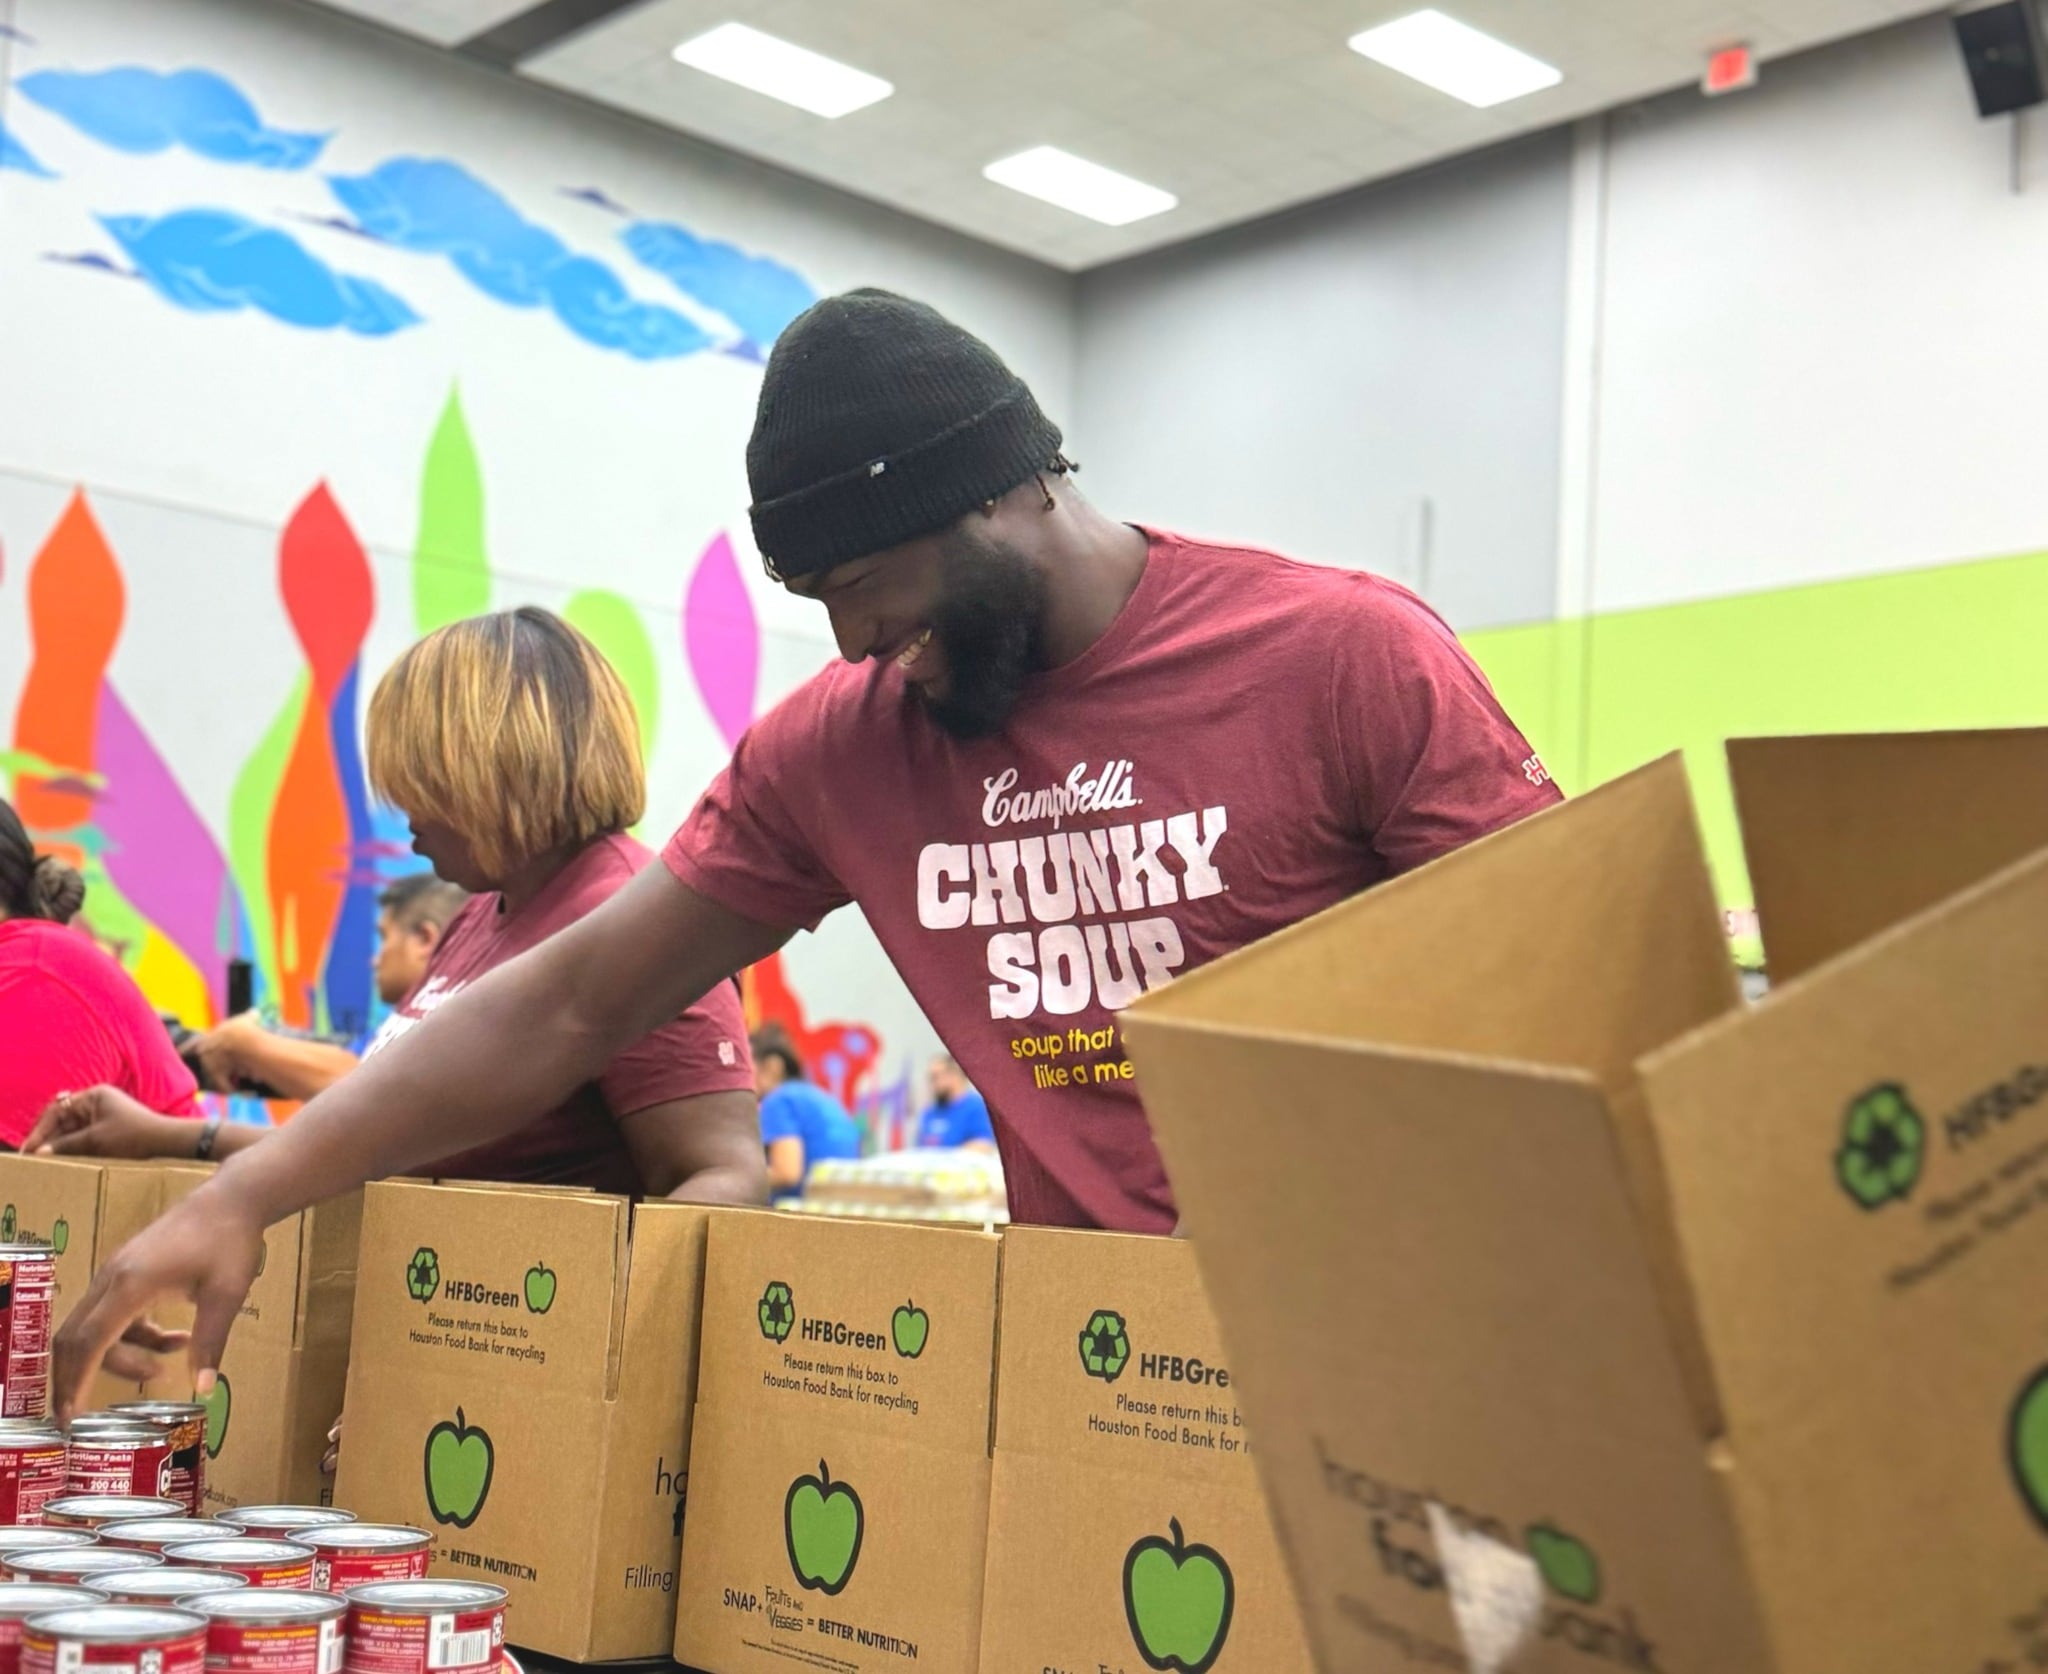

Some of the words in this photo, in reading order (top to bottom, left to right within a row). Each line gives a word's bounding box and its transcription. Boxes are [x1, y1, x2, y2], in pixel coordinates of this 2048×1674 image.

[982, 759, 1138, 830] Campbell's
[917, 805, 1228, 930] CHUNKY
[987, 916, 1185, 1019] SOUP
[1012, 1034, 1063, 1060] soup
[1068, 1025, 1115, 1052] that
[1034, 1064, 1069, 1089] like
[1072, 1066, 1089, 1085] a
[1095, 1060, 1135, 1083] me
[445, 1280, 519, 1308] HFBGreen
[428, 1312, 454, 1329] Please
[456, 1317, 481, 1333] return
[484, 1319, 498, 1335] this
[501, 1321, 517, 1338] box
[519, 1326, 528, 1339] to
[802, 1318, 886, 1351] HFBGreen
[409, 1328, 443, 1346] Houston
[445, 1333, 466, 1349] Food
[468, 1336, 489, 1353] Bank
[492, 1339, 504, 1355] for
[506, 1344, 545, 1364] recycling
[784, 1353, 813, 1372] Please
[816, 1360, 844, 1377] return
[847, 1362, 863, 1380] this
[866, 1365, 885, 1384] box
[888, 1371, 898, 1386] to
[1140, 1353, 1230, 1388] HFBGre
[763, 1370, 801, 1391] Houston
[803, 1377, 827, 1396] Food
[830, 1382, 853, 1400] Bank
[856, 1385, 871, 1403] for
[873, 1391, 919, 1415] recycling
[1116, 1393, 1157, 1415] Please
[1161, 1402, 1201, 1422] return
[1205, 1404, 1228, 1426] this
[1088, 1413, 1140, 1437] Houston
[1144, 1421, 1178, 1443] Food
[1182, 1426, 1216, 1449] Bank
[1219, 1430, 1241, 1452] for
[90, 1480, 109, 1491] 200
[450, 1549, 482, 1569] BETTER
[484, 1556, 538, 1582] NUTRITION
[625, 1563, 673, 1592] Filling
[818, 1617, 854, 1642] BETTER
[857, 1628, 919, 1660] NUTRITION
